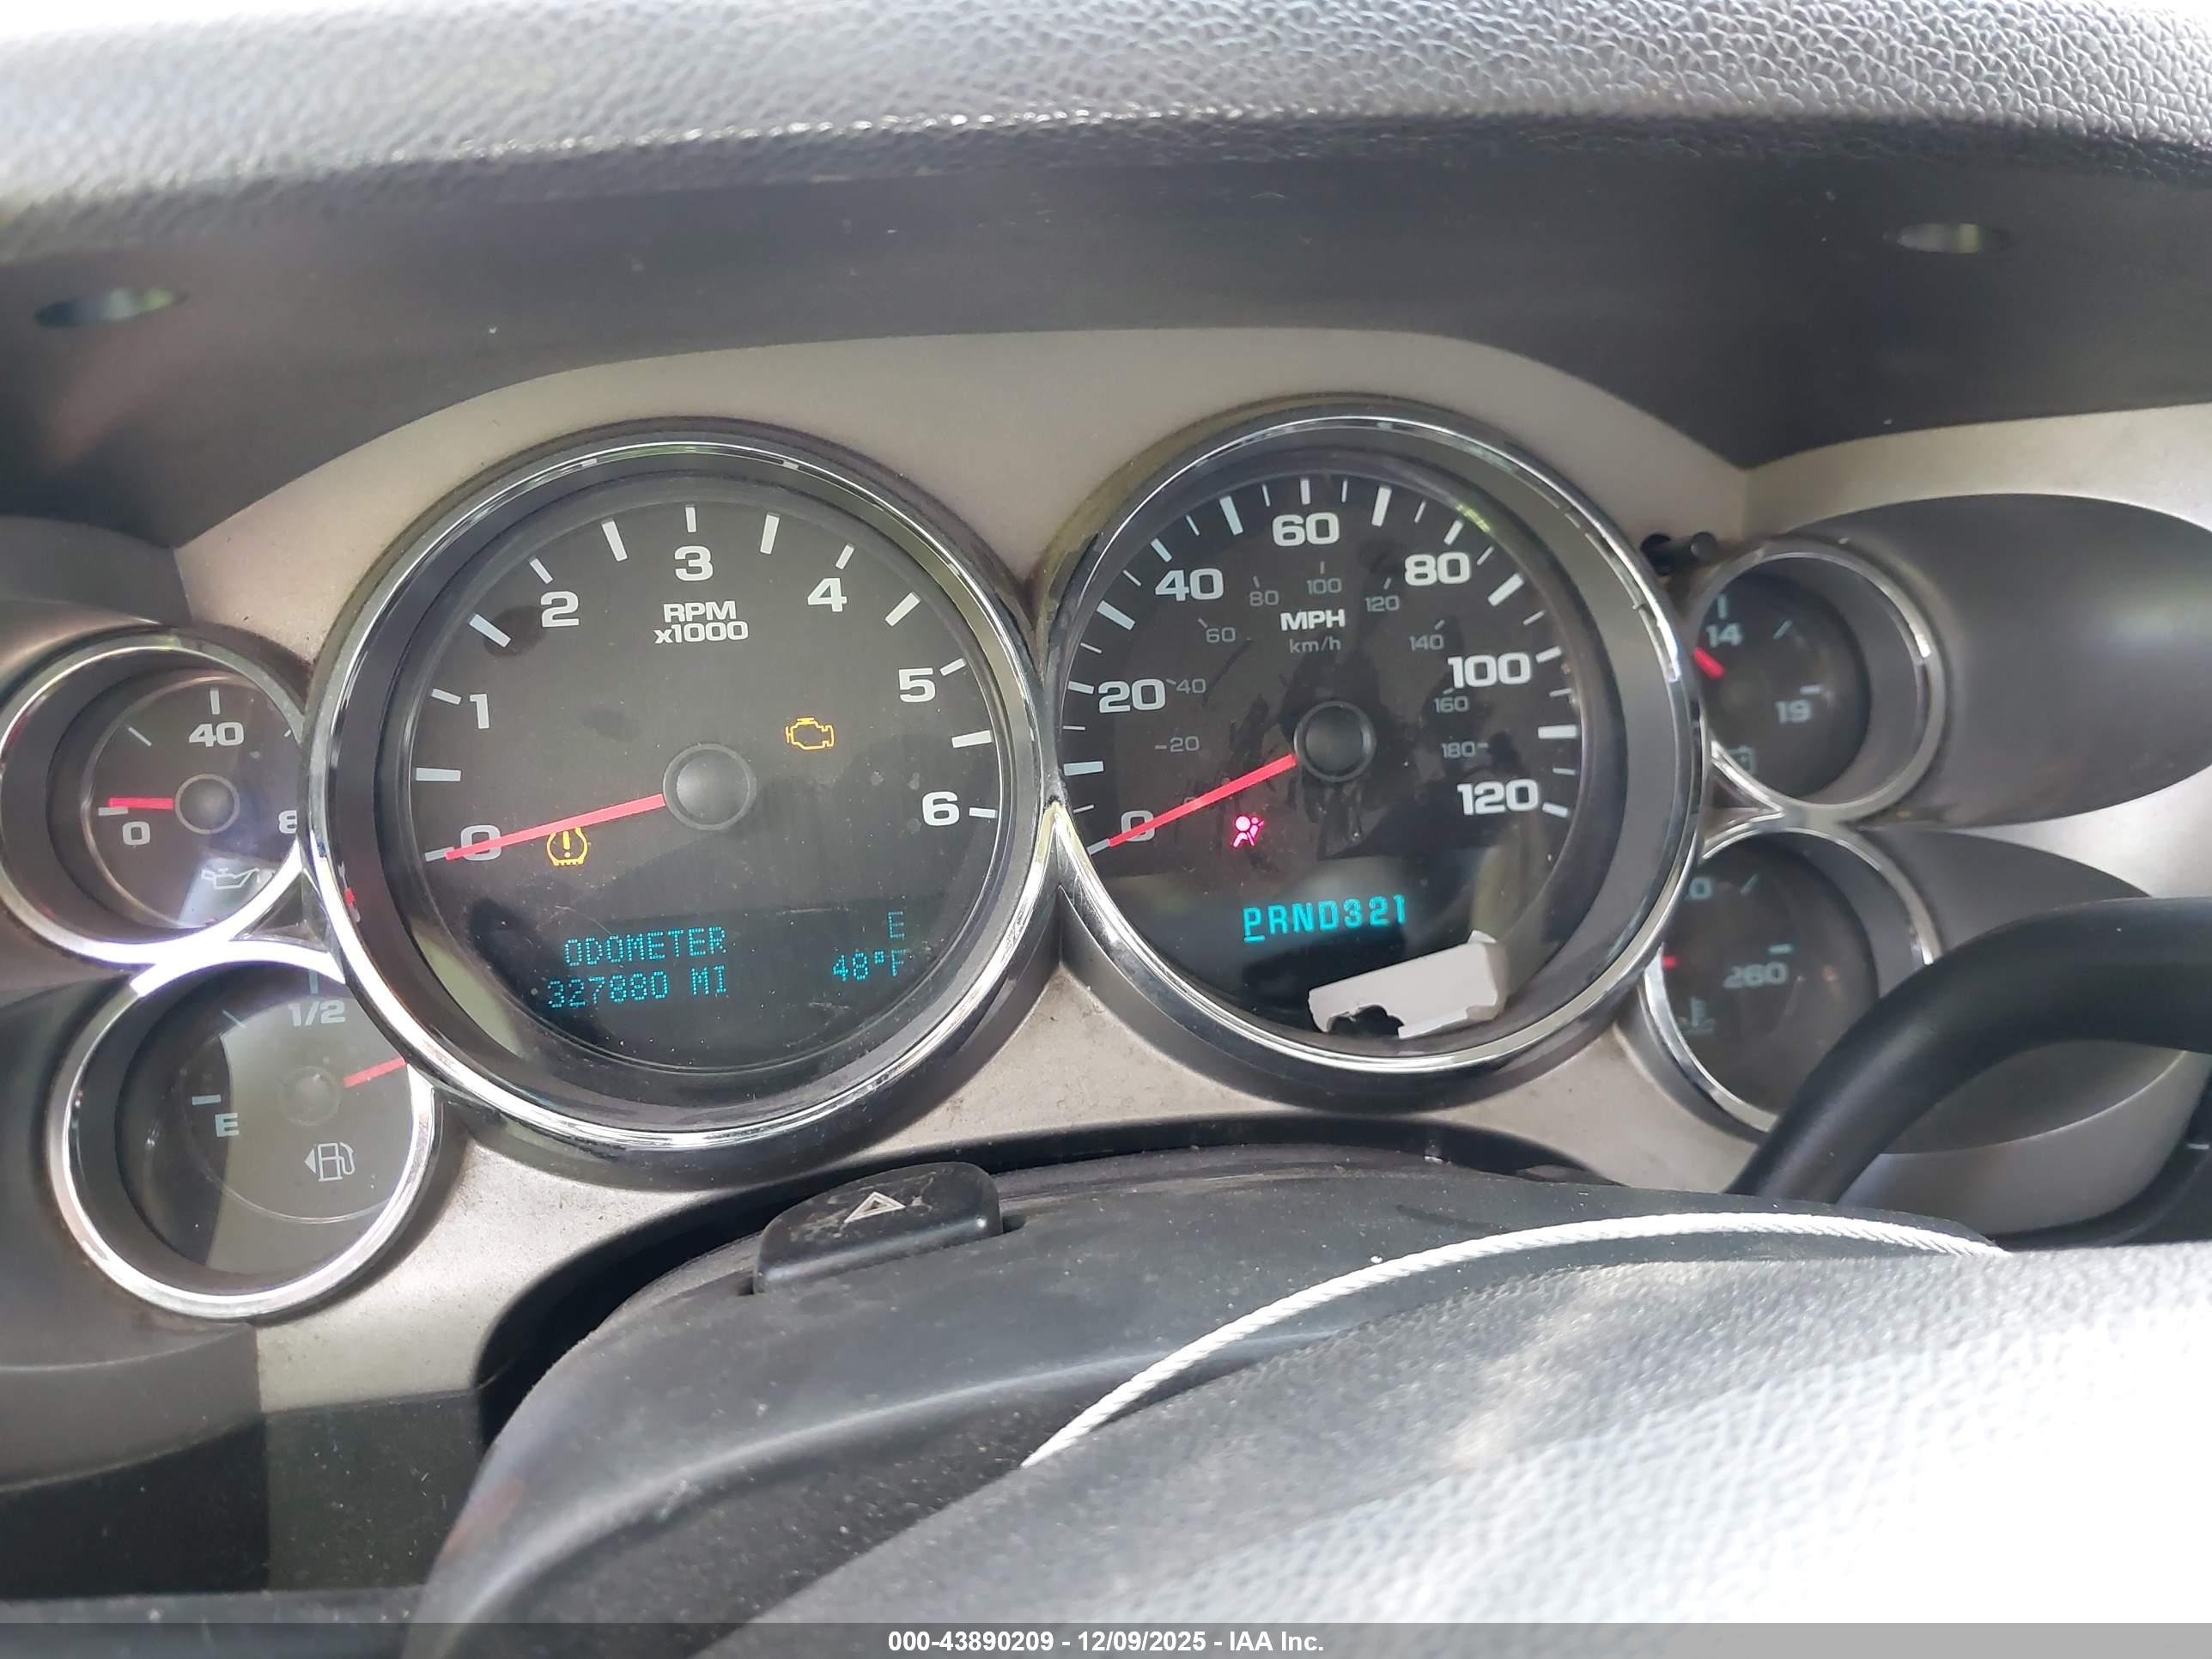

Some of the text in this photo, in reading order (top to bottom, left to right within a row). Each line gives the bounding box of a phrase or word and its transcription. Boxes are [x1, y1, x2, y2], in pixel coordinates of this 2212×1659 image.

[1272, 513, 1340, 546] 60
[674, 545, 714, 581] 3
[1404, 551, 1471, 586] 80
[807, 577, 848, 612] 4
[1155, 568, 1224, 601] 40
[1306, 577, 1342, 594] 100
[540, 591, 580, 627] 2
[1249, 590, 1279, 606] 80
[1366, 595, 1400, 611] 120
[663, 600, 737, 623] RPM
[1279, 609, 1346, 631] MPH
[653, 621, 749, 644] x1000
[1206, 627, 1236, 643] 60
[1289, 636, 1341, 653] km/h
[1409, 634, 1444, 651] 140
[1706, 624, 1744, 646] 14
[1447, 652, 1531, 688] 100
[898, 667, 936, 702] 5
[1097, 678, 1166, 714] 20
[1176, 678, 1206, 694] 40
[470, 693, 489, 729] 1
[1434, 696, 1469, 713] 160
[1774, 699, 1812, 724] 19
[188, 721, 244, 747] 40
[1170, 736, 1200, 752] 20
[1442, 741, 1477, 758] 180
[921, 791, 960, 826] 6
[1457, 778, 1540, 815] 120
[122, 821, 151, 846] 0
[1121, 810, 1156, 842] 0
[460, 824, 502, 861] 0
[888, 911, 905, 939] E
[563, 926, 727, 967] ODOMETER
[546, 964, 727, 1009] 327880 MI
[288, 1000, 346, 1026] 1/2
[215, 1112, 240, 1138] E
